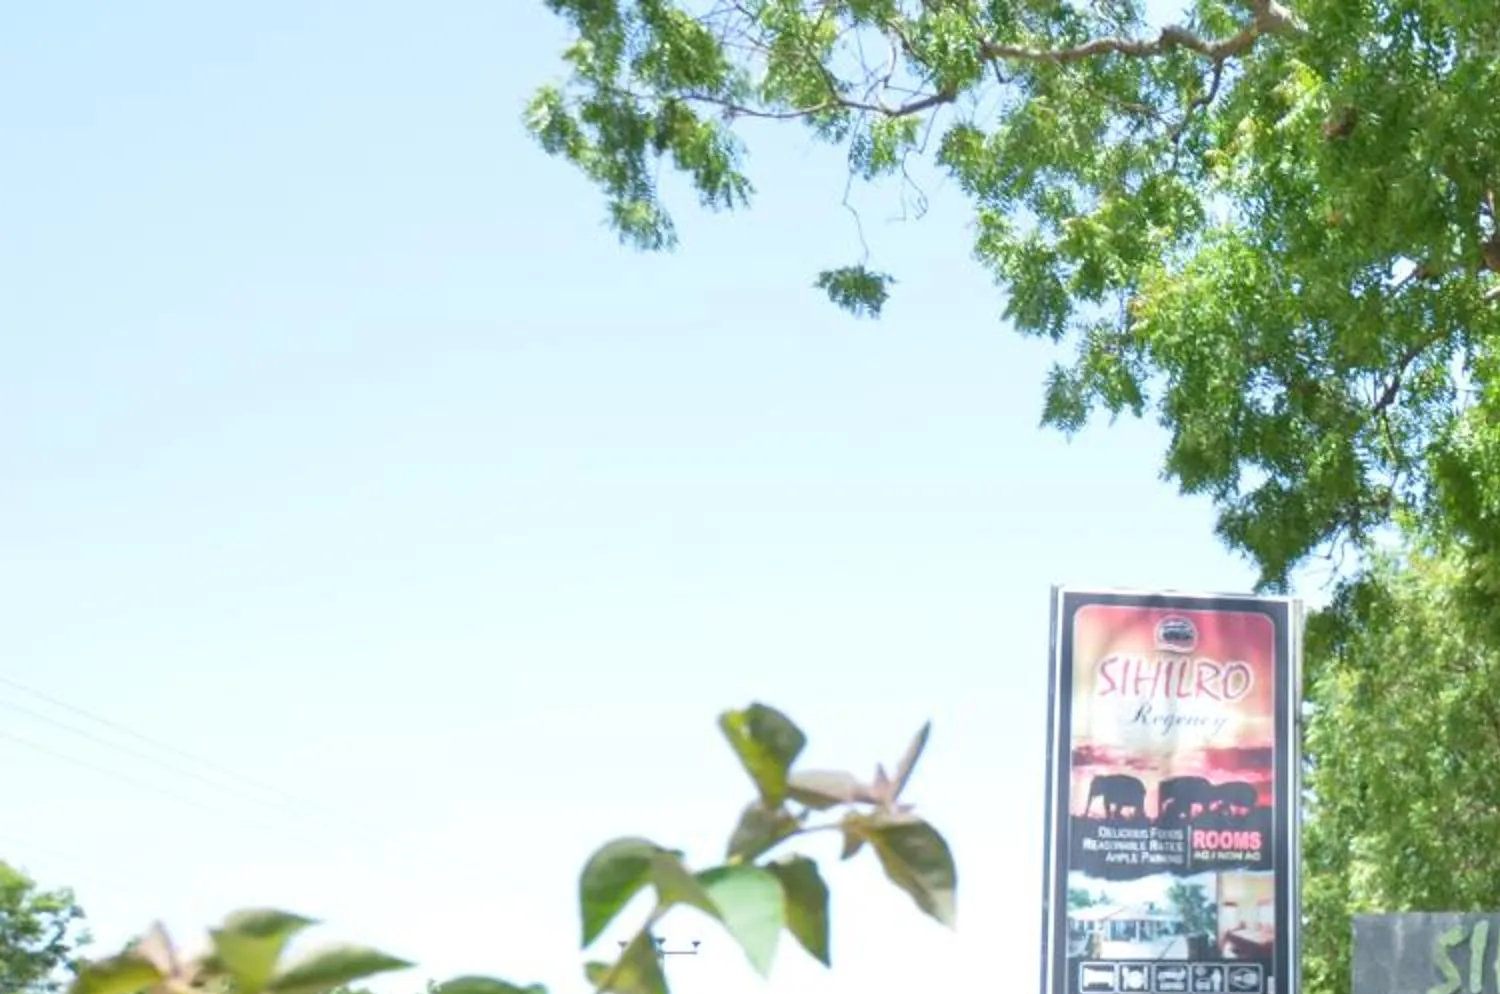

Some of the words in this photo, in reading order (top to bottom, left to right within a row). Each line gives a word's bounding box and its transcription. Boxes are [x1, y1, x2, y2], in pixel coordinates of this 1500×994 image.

[1099, 656, 1251, 701] SIHILRO
[1131, 702, 1228, 736] Regency
[1193, 829, 1262, 850] ROOMS
